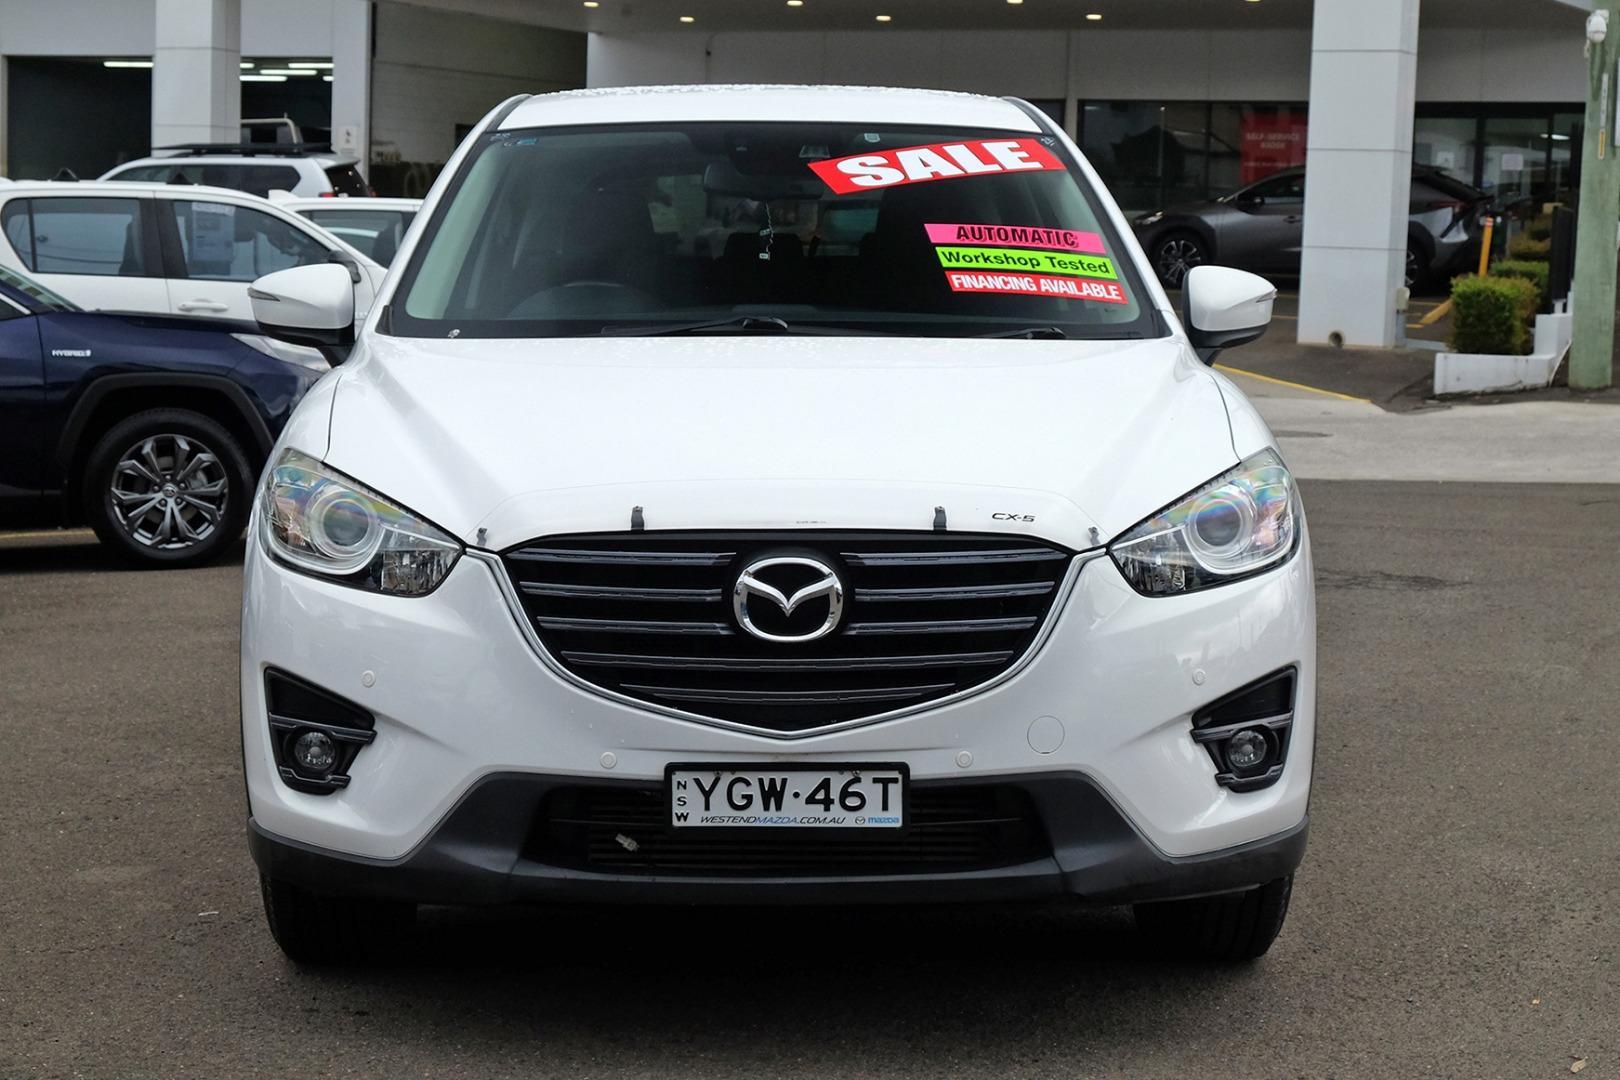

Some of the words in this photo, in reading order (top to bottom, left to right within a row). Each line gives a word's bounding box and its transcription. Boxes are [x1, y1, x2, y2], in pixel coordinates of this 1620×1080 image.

[836, 141, 1044, 187] SALE
[956, 225, 1079, 248] AUTOMATIC
[942, 251, 1041, 269] Workshop
[1044, 256, 1111, 274] Tested
[951, 275, 1036, 292] FINANCING
[1040, 278, 1122, 300] AVAILABLE
[992, 512, 1036, 522] CX-5
[700, 815, 845, 825] WESTENDMAZDA.COM.AU
[868, 815, 900, 824] mazda
